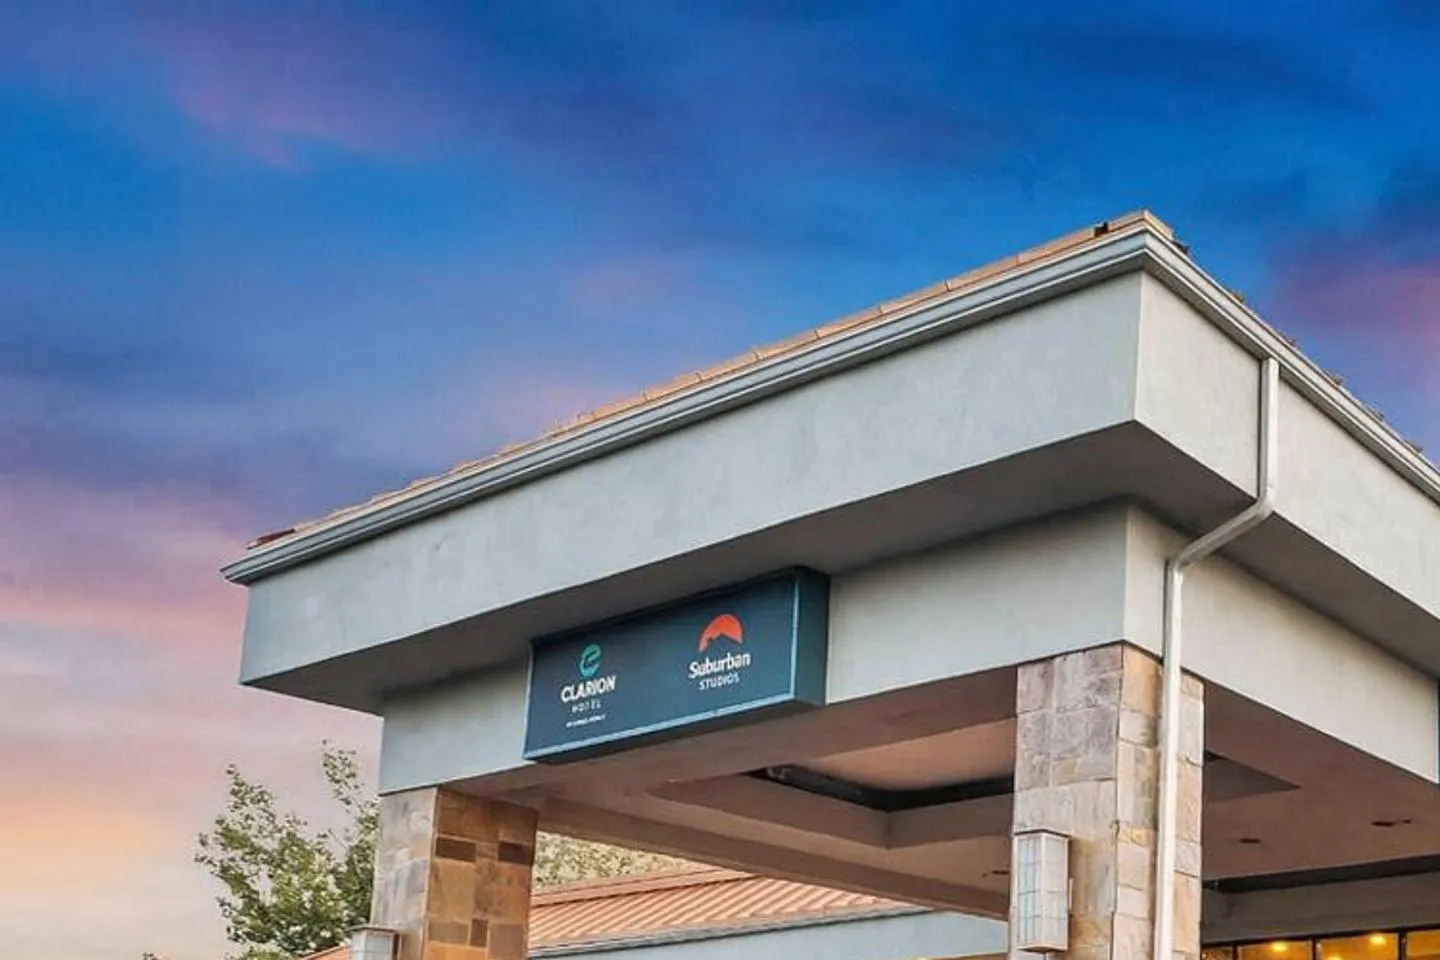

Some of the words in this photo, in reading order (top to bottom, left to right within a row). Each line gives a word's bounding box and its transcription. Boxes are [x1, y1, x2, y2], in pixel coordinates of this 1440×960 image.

[688, 652, 751, 679] Suburban
[560, 675, 616, 702] CLARION
[700, 672, 740, 690] STUDIOS
